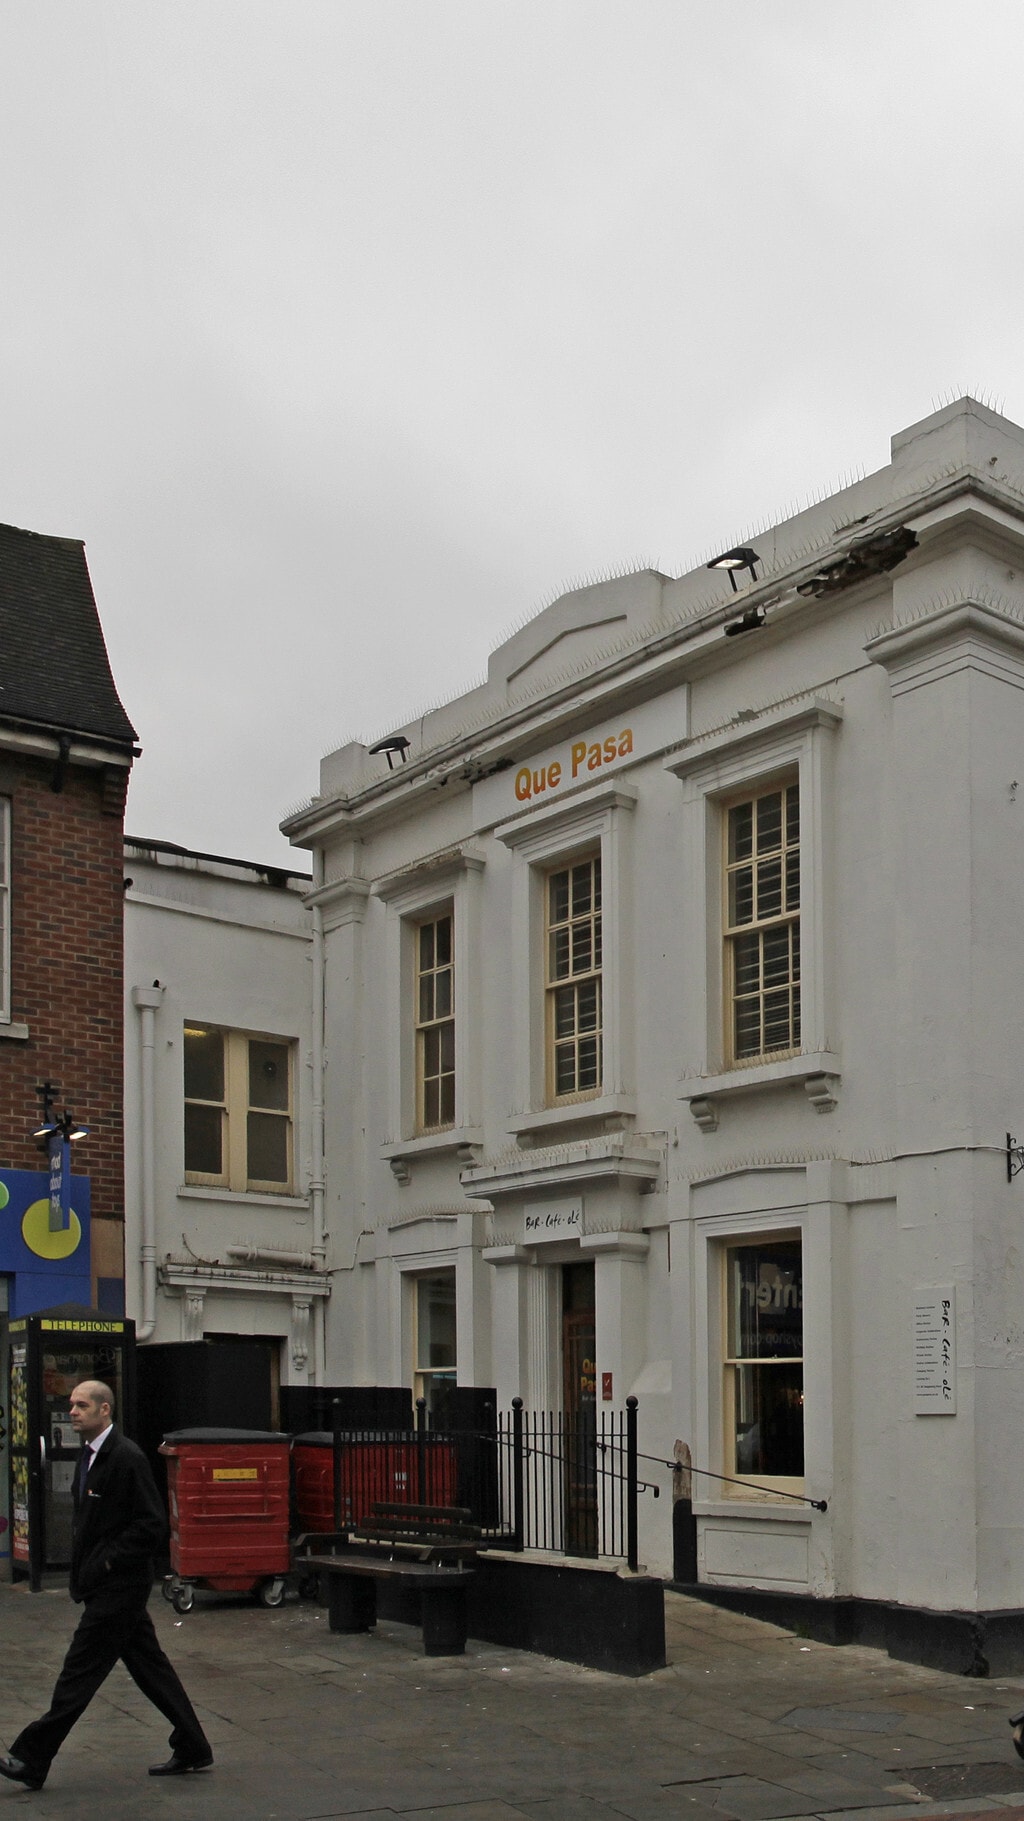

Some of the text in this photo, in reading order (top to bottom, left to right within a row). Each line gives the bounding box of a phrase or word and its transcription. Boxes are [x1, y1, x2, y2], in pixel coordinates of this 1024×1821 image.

[515, 728, 633, 801] Que Pasa
[51, 1320, 116, 1332] TELEPHONE
